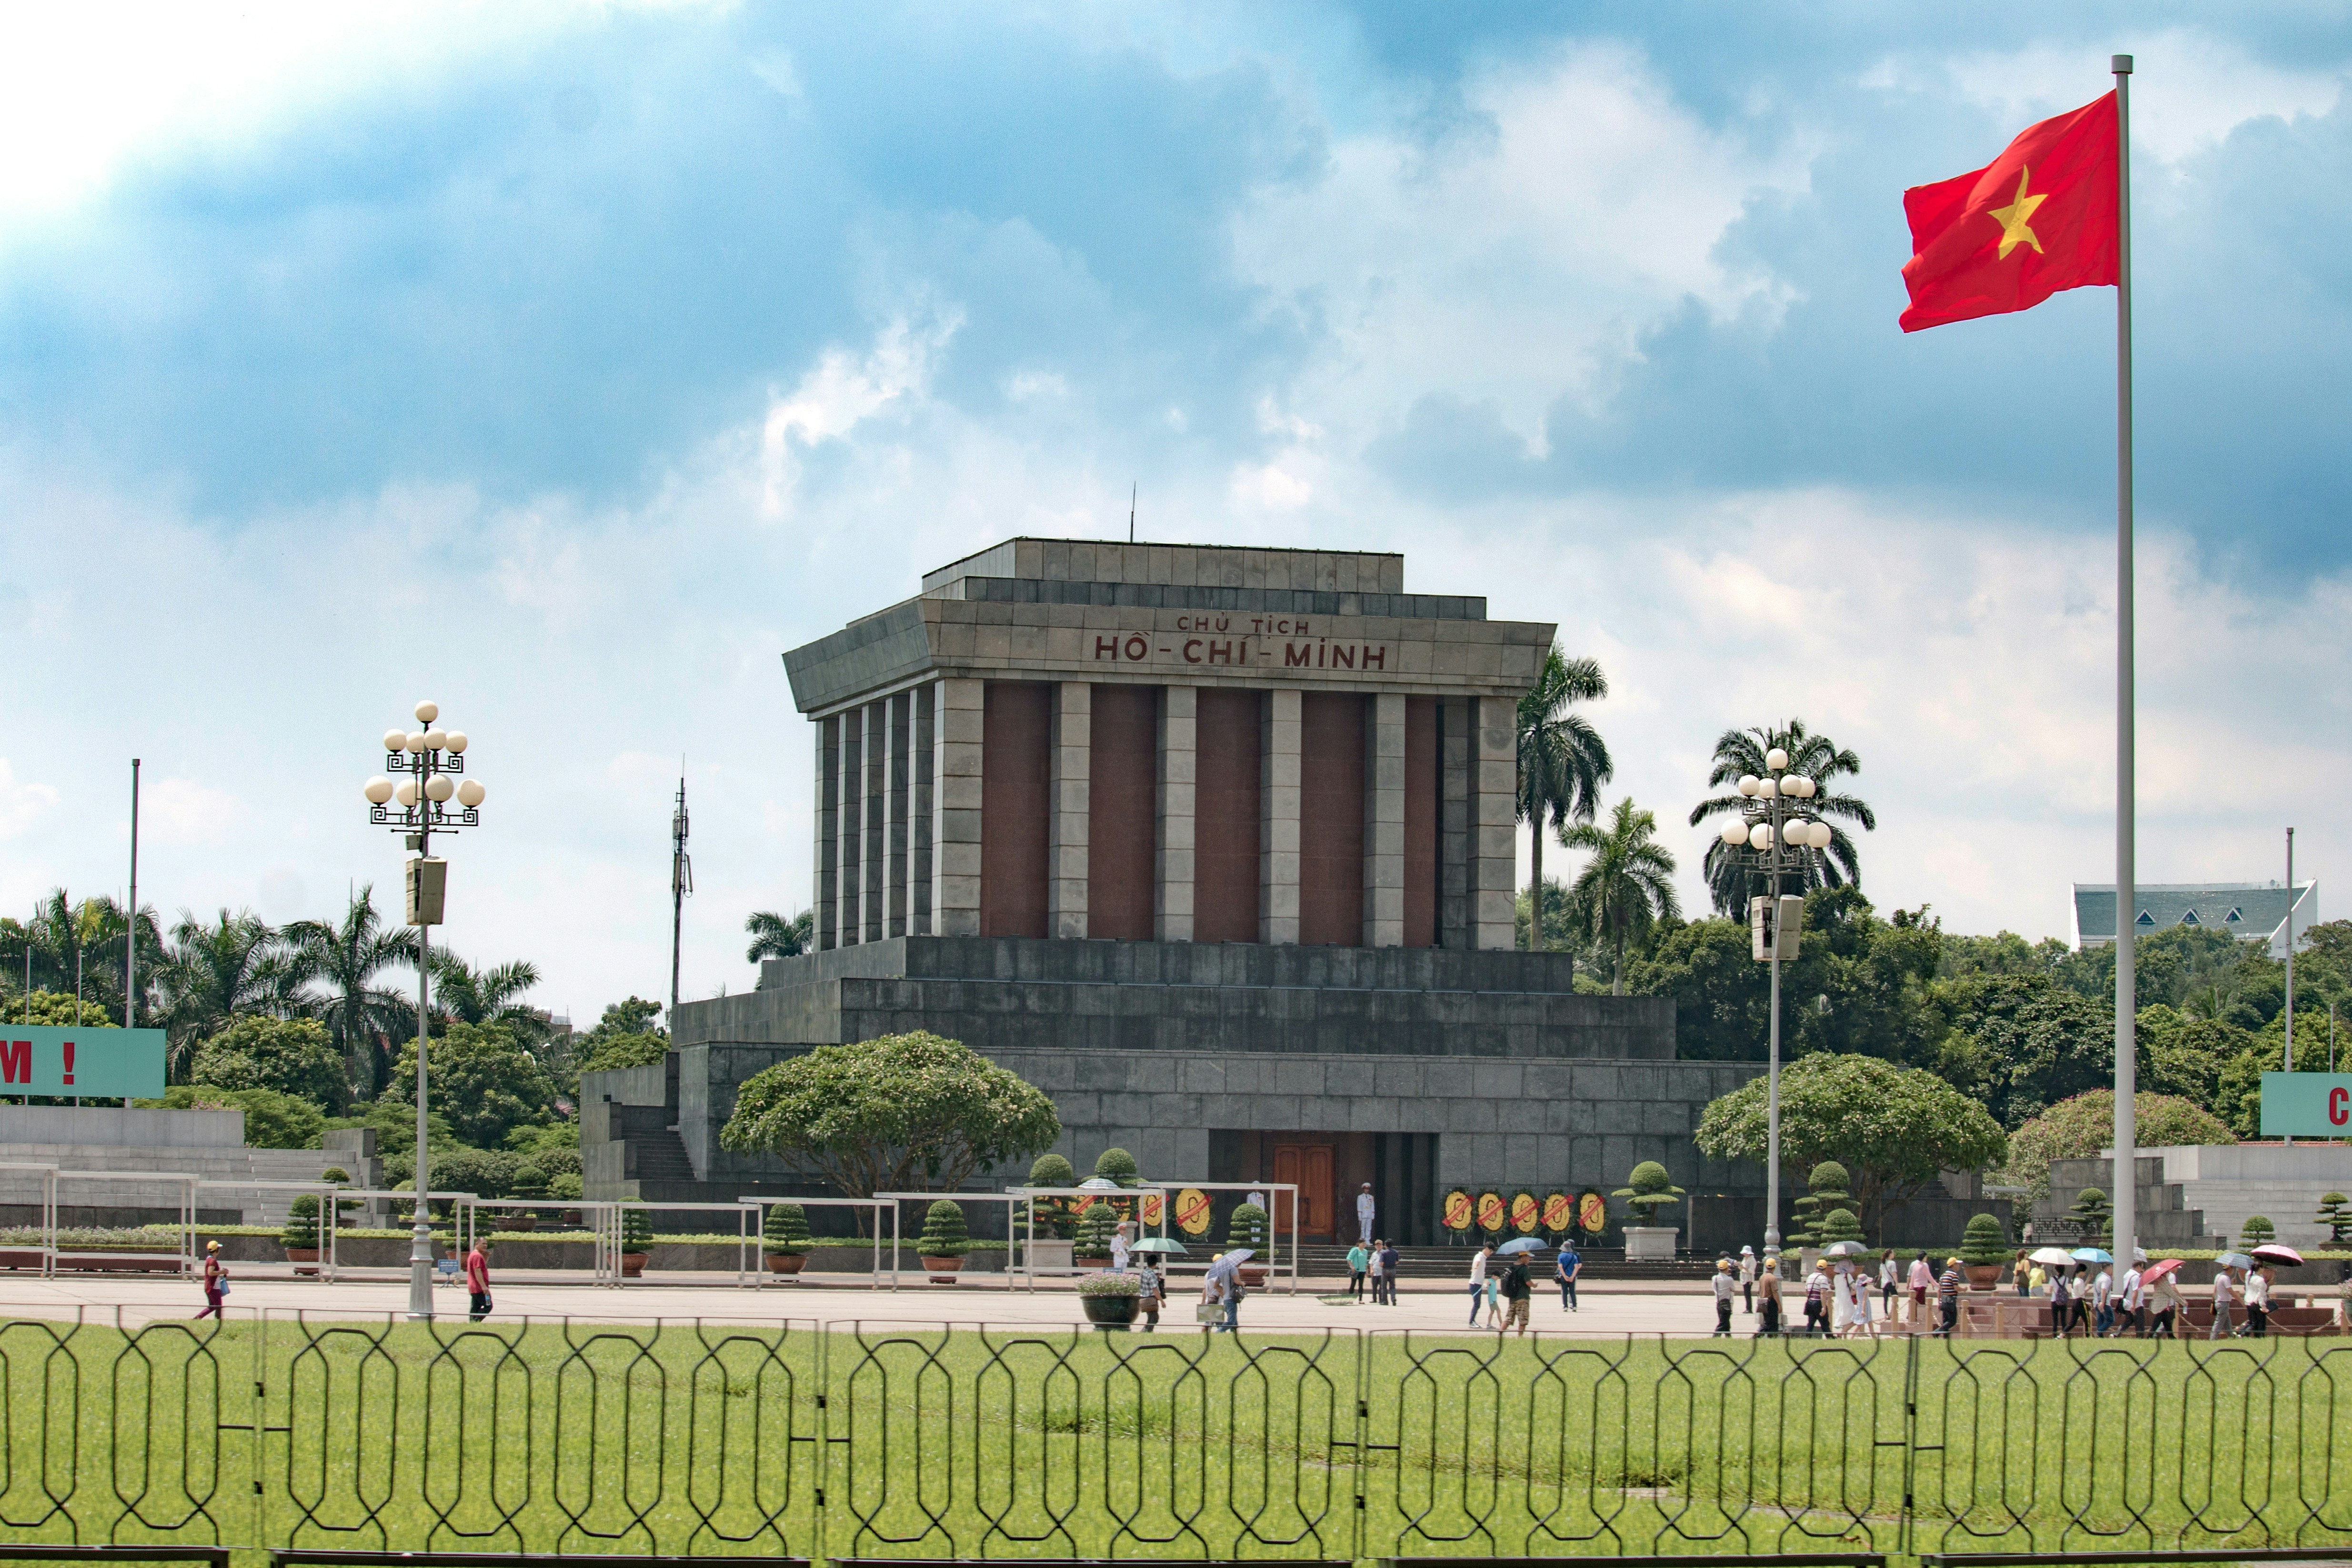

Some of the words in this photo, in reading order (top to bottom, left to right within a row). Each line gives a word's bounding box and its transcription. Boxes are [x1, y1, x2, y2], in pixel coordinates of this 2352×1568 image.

[1177, 612, 1229, 632] CHỦ
[1095, 632, 1150, 661] HỒ
[1183, 635, 1251, 665] CHÍ
